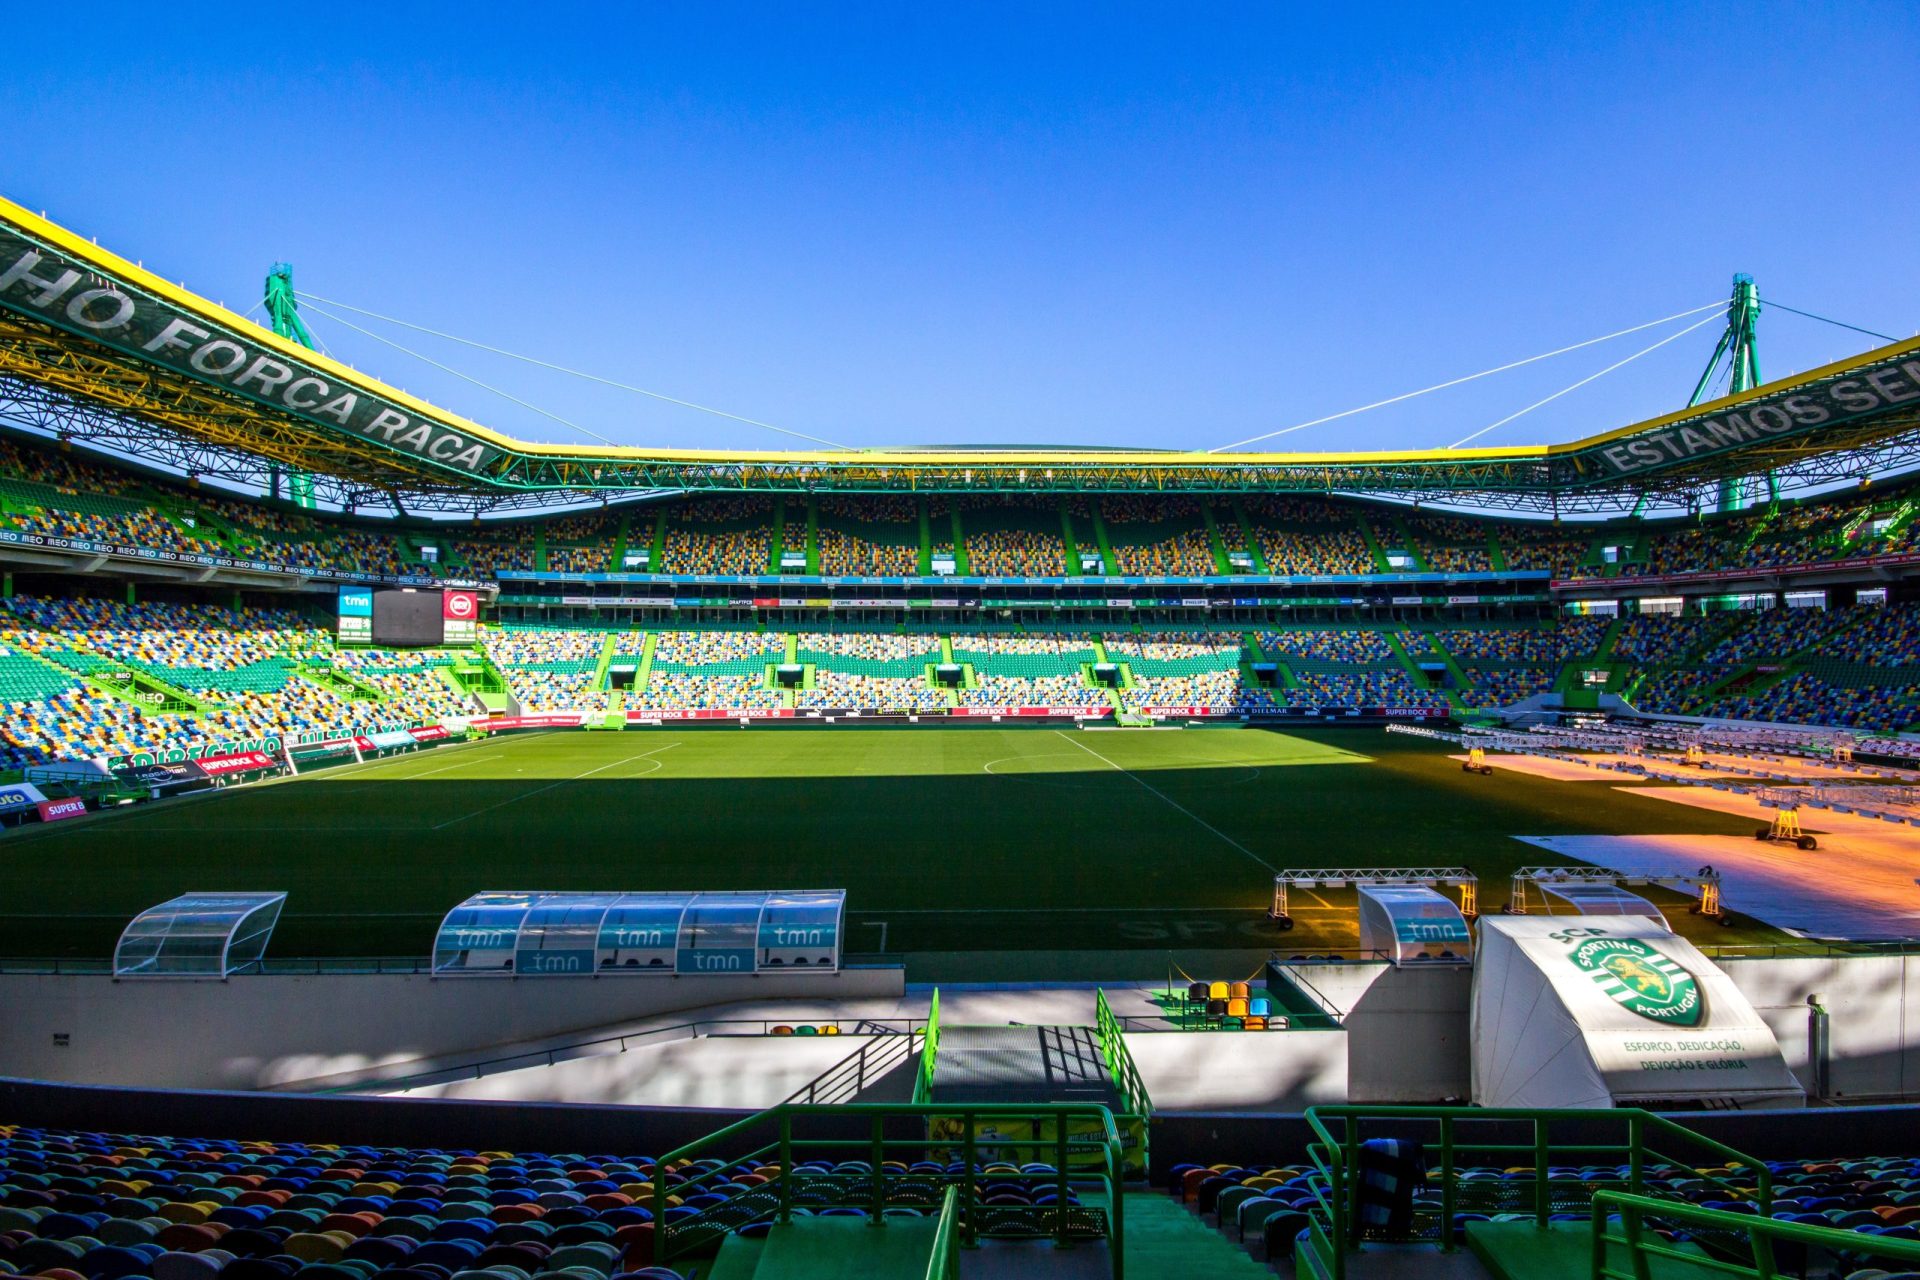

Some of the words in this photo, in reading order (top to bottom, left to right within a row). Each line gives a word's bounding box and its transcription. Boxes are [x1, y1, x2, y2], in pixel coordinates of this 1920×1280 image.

[142, 318, 359, 426] FORÇA
[363, 406, 486, 472] RAÇA
[1602, 394, 1831, 473] ESTAMOS
[1828, 358, 1920, 413] SE
[22, 534, 43, 544] MEO
[48, 538, 68, 548] MEO
[70, 540, 90, 550] MEO
[94, 544, 113, 553] MEO
[117, 546, 136, 556] MEO
[138, 550, 156, 558] MEO
[159, 552, 176, 560] MEO
[180, 554, 196, 562] MEO
[343, 596, 368, 606] tmn
[136, 693, 164, 704] MEO
[202, 758, 231, 770] SUPER
[231, 756, 252, 766] BOCK
[49, 803, 77, 815] SUPER
[455, 929, 502, 947] tmn
[615, 928, 661, 946] tmn
[774, 927, 820, 945] tmn
[1408, 921, 1456, 940] tmn
[1549, 928, 1608, 944] SCP
[533, 953, 579, 971] tmn
[693, 951, 740, 970] tmn
[1578, 940, 1645, 968] SPORTING
[1636, 987, 1697, 1017] PORTUGAL
[1624, 1041, 1676, 1054] ESFORÇO,
[1679, 1039, 1745, 1053] DEDICAÇÃO,
[1640, 1059, 1695, 1072] DEVOÇÃO
[1697, 1060, 1704, 1069] E
[1706, 1058, 1748, 1069] GLÓRIA
